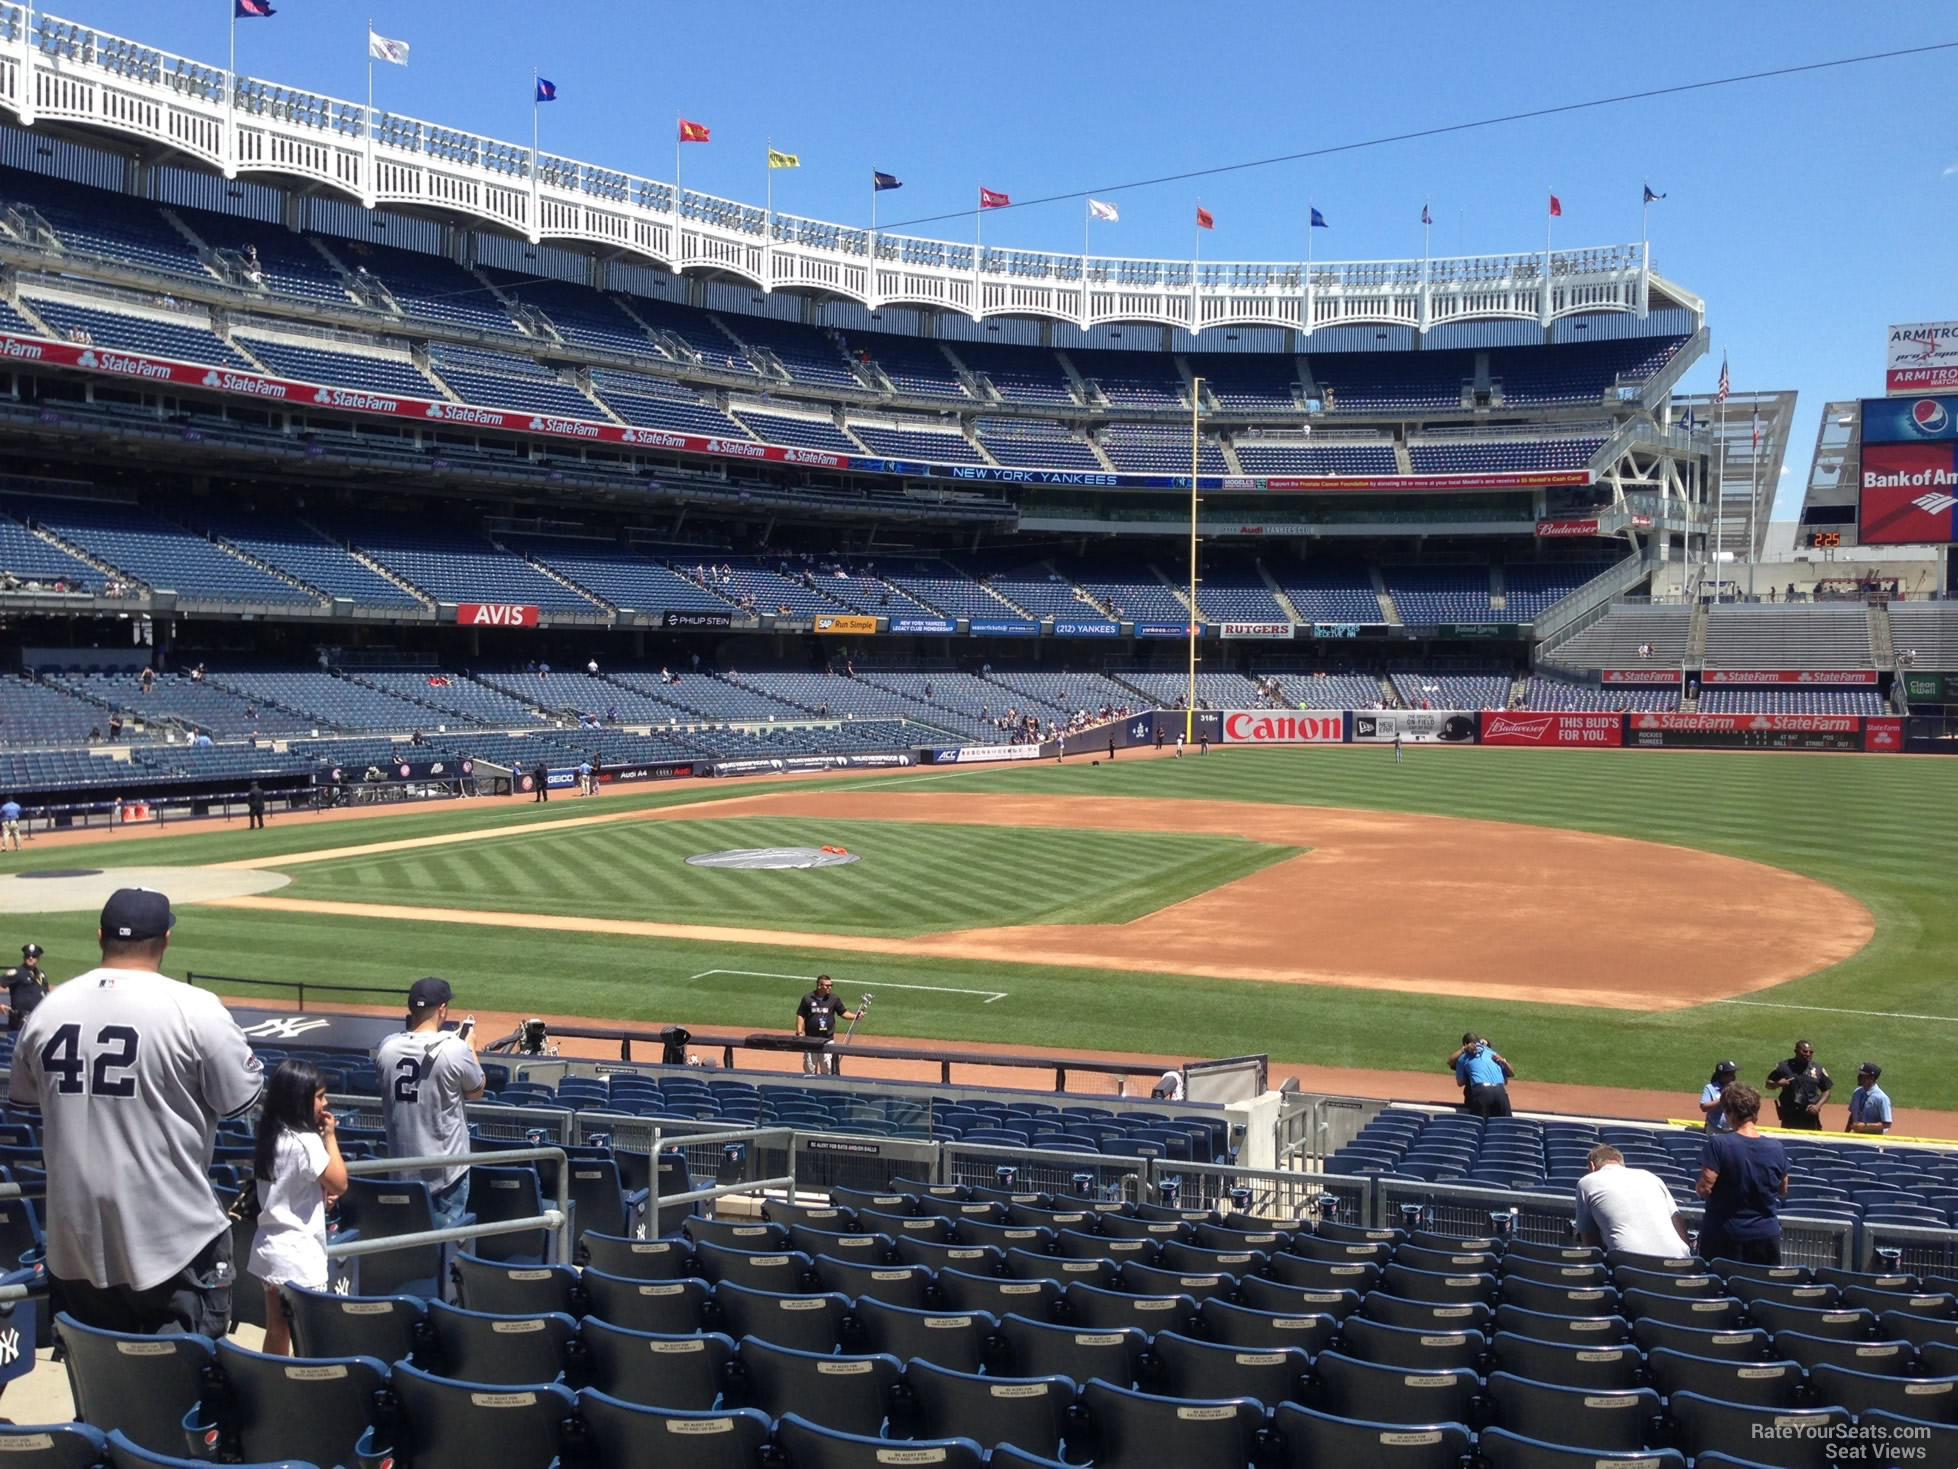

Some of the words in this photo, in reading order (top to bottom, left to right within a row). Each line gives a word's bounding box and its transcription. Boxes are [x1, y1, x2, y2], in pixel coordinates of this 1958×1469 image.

[1930, 377, 1958, 386] WATCH
[954, 467, 987, 478] NEW
[993, 470, 1033, 481] YORK
[1042, 473, 1117, 485] YANKEES
[1864, 471, 1910, 488] Bank
[1912, 469, 1931, 485] of
[1240, 526, 1263, 534] Audi
[1266, 526, 1296, 534] YANKEES
[1537, 523, 1597, 535] Budweiser
[473, 605, 524, 625] AVIS
[679, 616, 706, 625] PHILIP
[707, 617, 729, 625] STEIN
[818, 619, 832, 629] SAP
[850, 621, 872, 630] Simple
[1056, 624, 1075, 634] (212)
[1077, 624, 1115, 633] YANKEES
[1142, 626, 1180, 634] yankees.com
[1224, 625, 1289, 634] RUTGERS
[1225, 713, 1341, 740] Canon
[1492, 720, 1544, 733] Budweiser
[1559, 717, 1582, 728] THIS
[1586, 717, 1619, 728] BUD'S
[1558, 730, 1579, 741] FOR
[1582, 730, 1607, 741] YOU.
[936, 751, 957, 759] ACC
[674, 767, 692, 775] Audi
[547, 774, 574, 784] GEICO
[41, 1022, 141, 1099] 42
[394, 1056, 421, 1105] 2
